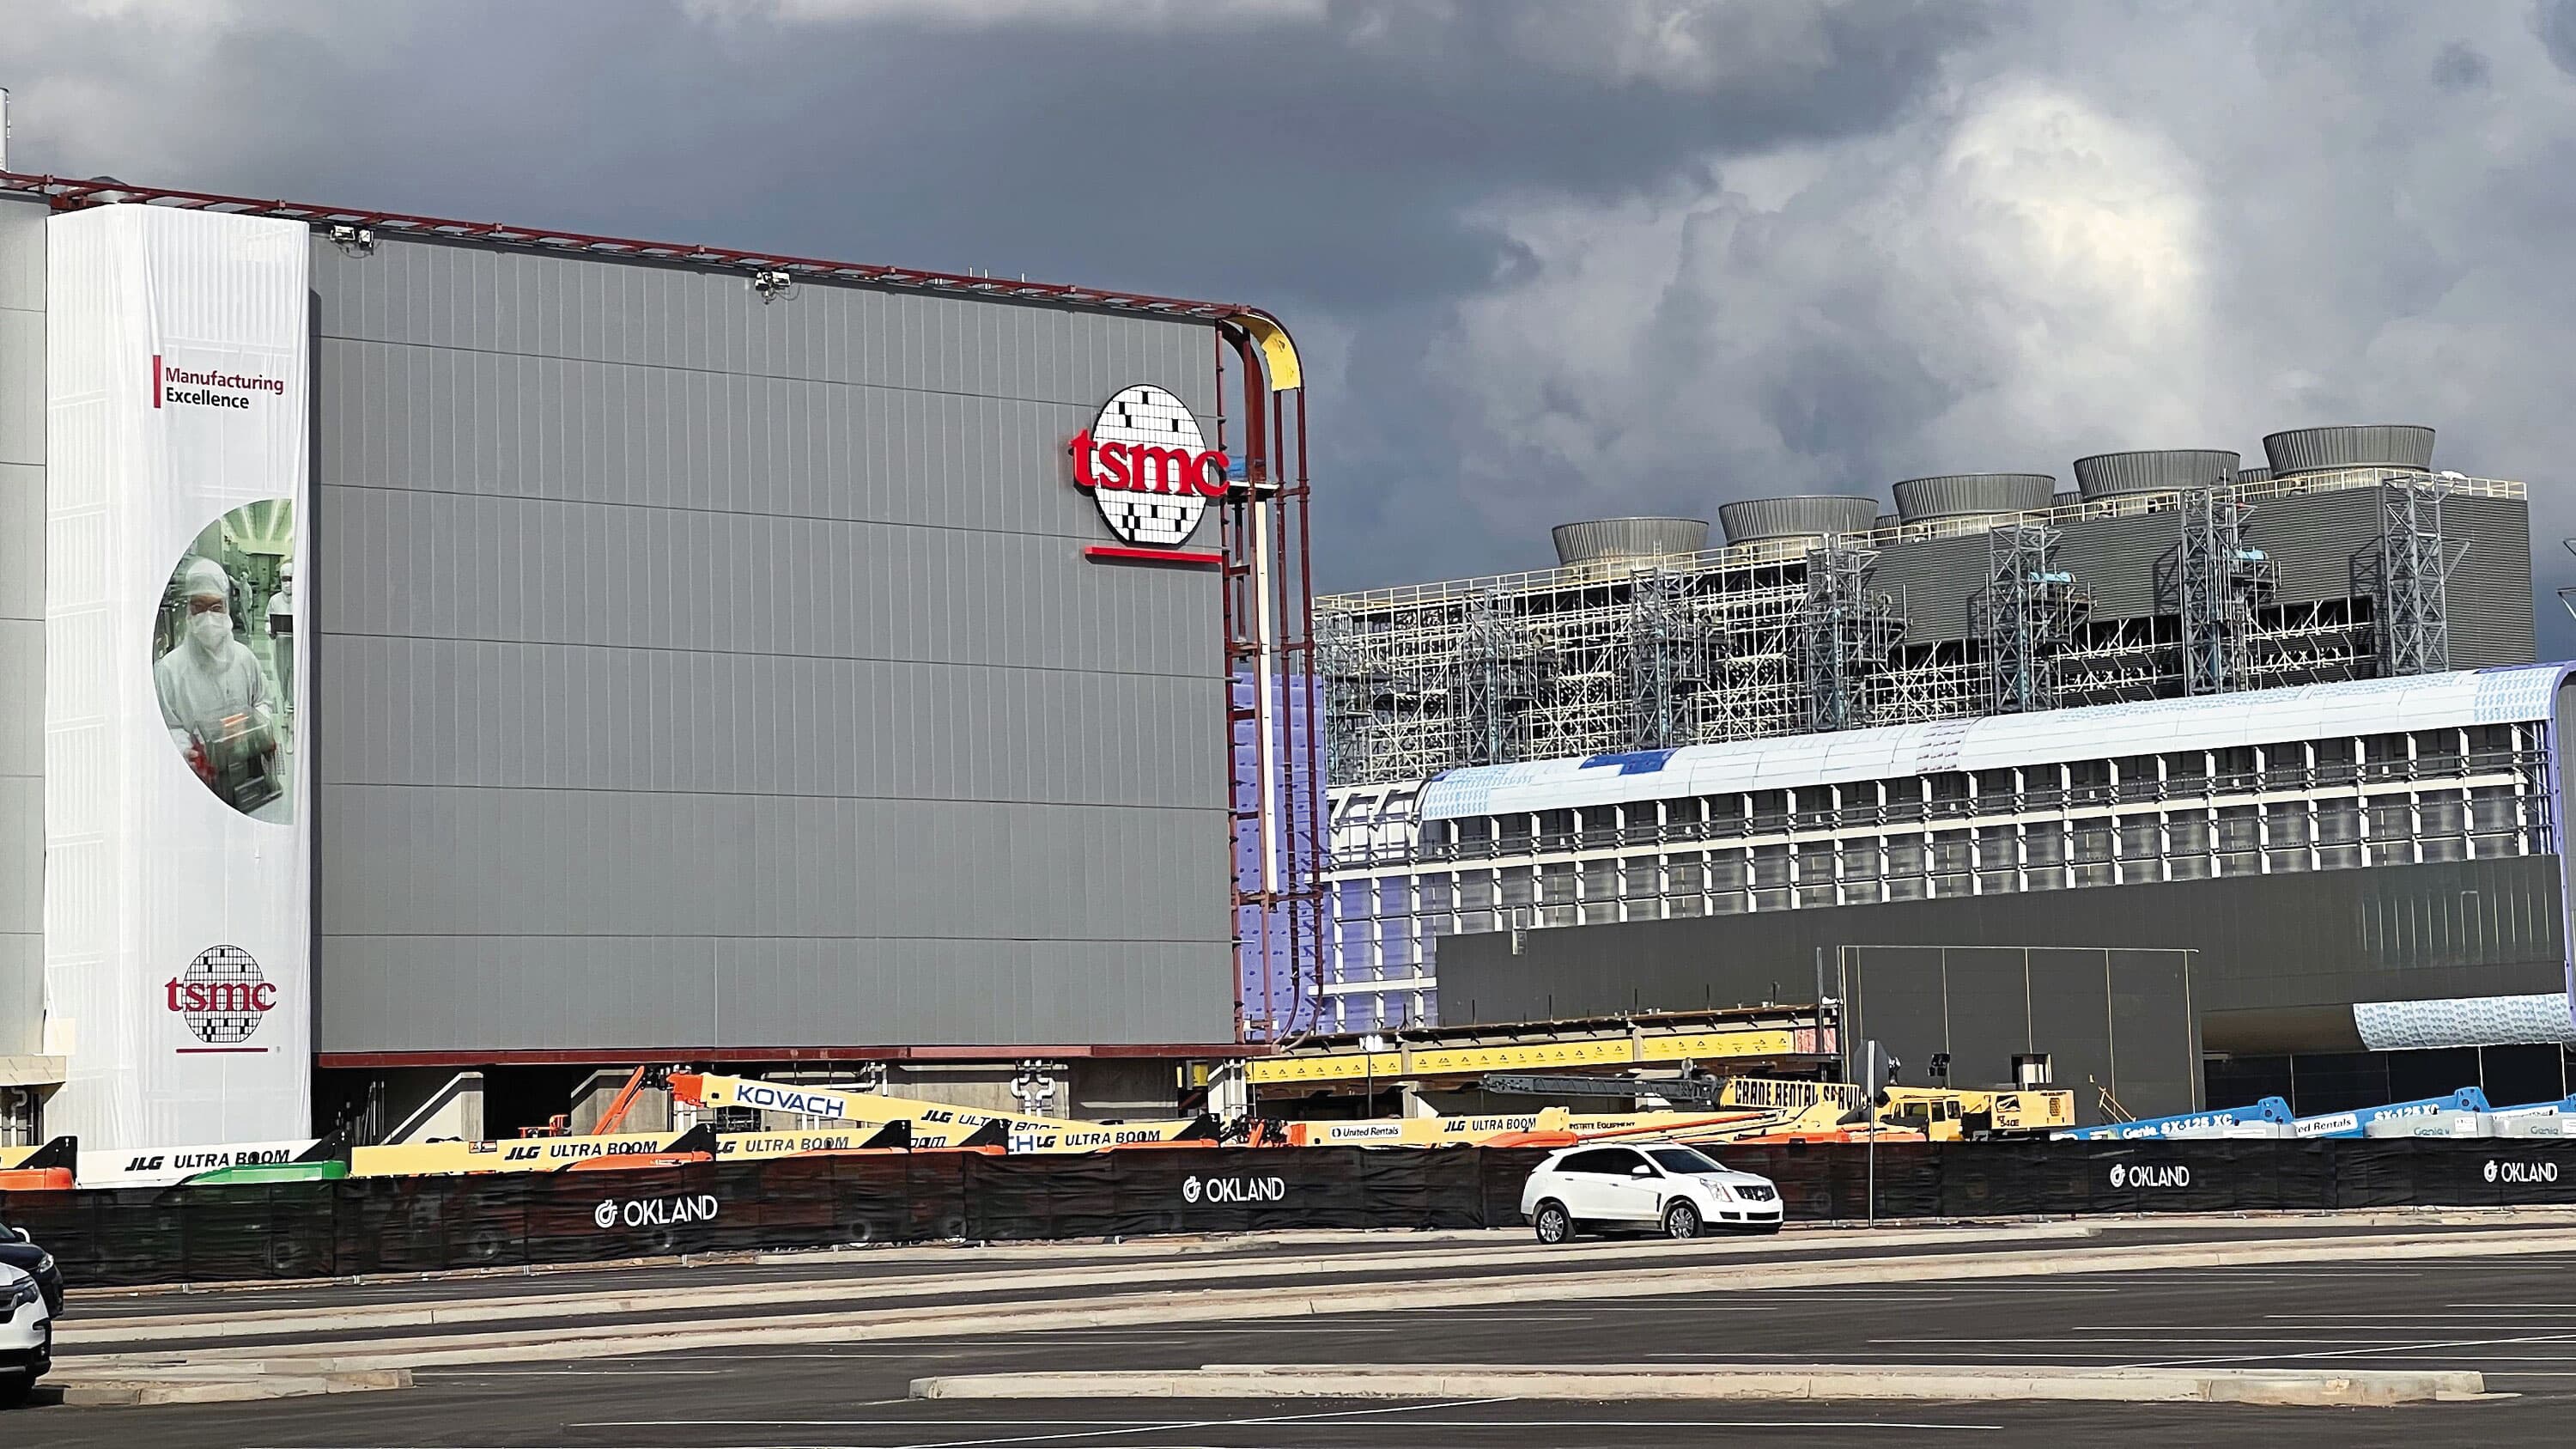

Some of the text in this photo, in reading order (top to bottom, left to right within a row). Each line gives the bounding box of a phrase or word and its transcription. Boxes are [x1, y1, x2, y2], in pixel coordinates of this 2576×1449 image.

[166, 367, 284, 395] Manufacturing
[166, 387, 250, 409] Excellence
[1068, 429, 1230, 498] tsmc
[164, 977, 276, 1012] tsmc
[736, 1085, 844, 1117] KOVACH
[1735, 1080, 1771, 1105] CRANE
[1775, 1082, 1818, 1108] RENTAL
[920, 1110, 953, 1123] JLG
[1443, 1117, 1536, 1132] JLG ULTRA BOOM
[2123, 1126, 2157, 1139] Genie
[2160, 1118, 2208, 1134] SX-125
[2213, 1114, 2233, 1126] XC
[2313, 1118, 2352, 1130] Rentals
[1036, 1135, 1057, 1148] LG
[1065, 1132, 1111, 1146] ULTRA
[1115, 1130, 1160, 1143] BOOM
[1343, 1125, 1399, 1136] United Rentals
[504, 1141, 658, 1160] JLG ULTRA BOOM
[715, 1136, 849, 1154] LG ULTRA BOOM
[125, 1149, 291, 1172] JLG ULTRA BOOM
[2129, 1166, 2190, 1187] OKLAND
[2500, 1162, 2558, 1183] OKLAND
[1206, 1177, 1285, 1202] OKLAND
[623, 1195, 719, 1227] OKLAND
